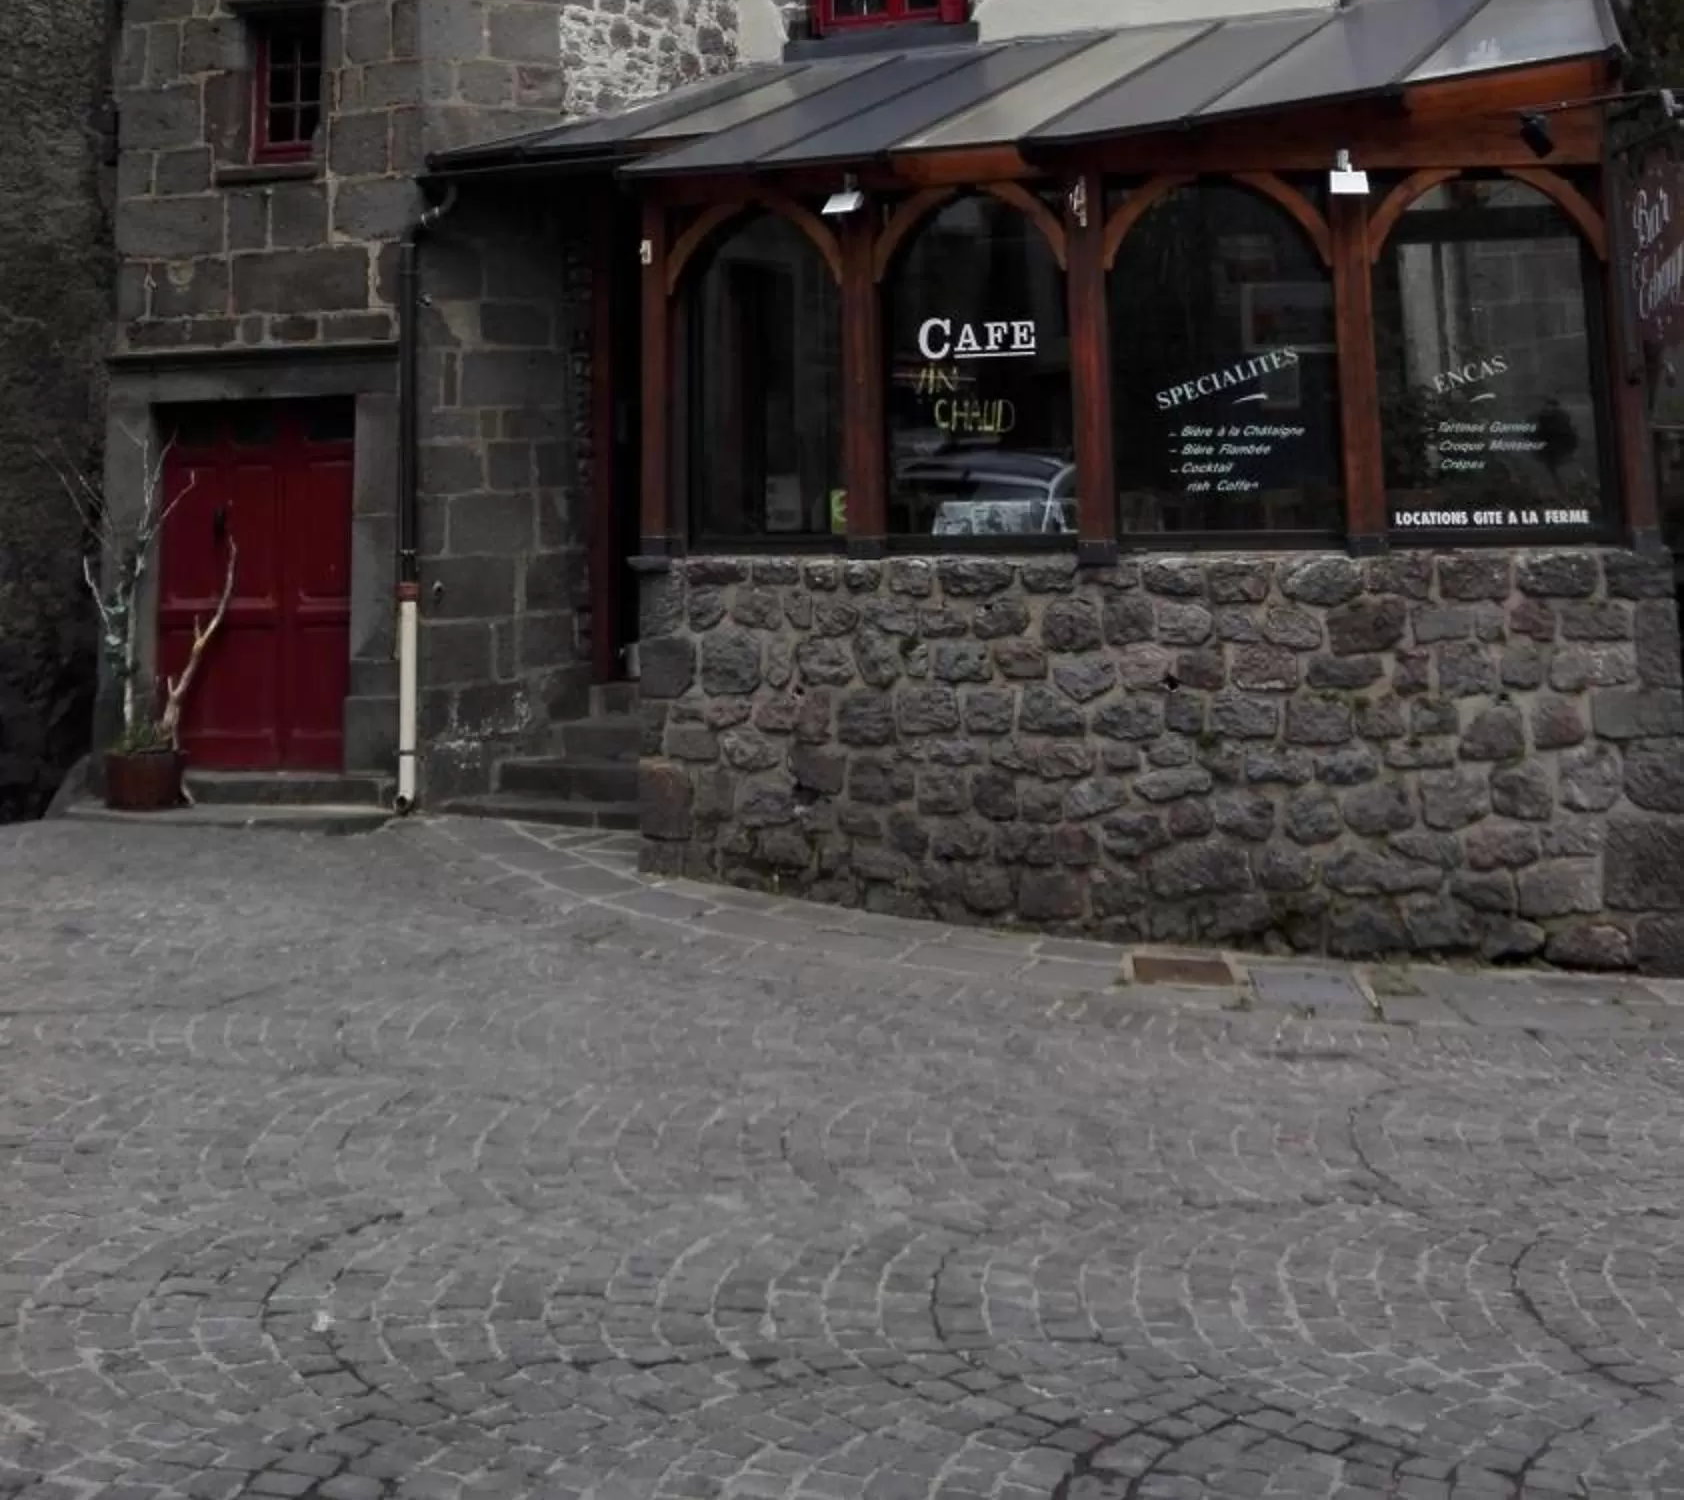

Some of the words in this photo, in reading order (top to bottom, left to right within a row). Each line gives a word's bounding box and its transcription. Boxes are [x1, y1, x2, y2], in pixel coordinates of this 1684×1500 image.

[918, 317, 1036, 359] CAFE
[1155, 345, 1299, 410] SPECIALITES
[1433, 355, 1508, 394] ENCAS
[1228, 425, 1241, 437] la
[1181, 461, 1235, 474] Cocktail
[1395, 511, 1469, 526] LOCATIONS
[1473, 510, 1504, 525] GITE
[1507, 510, 1519, 525] A
[1521, 510, 1540, 525] LA
[1544, 509, 1590, 524] FERME
